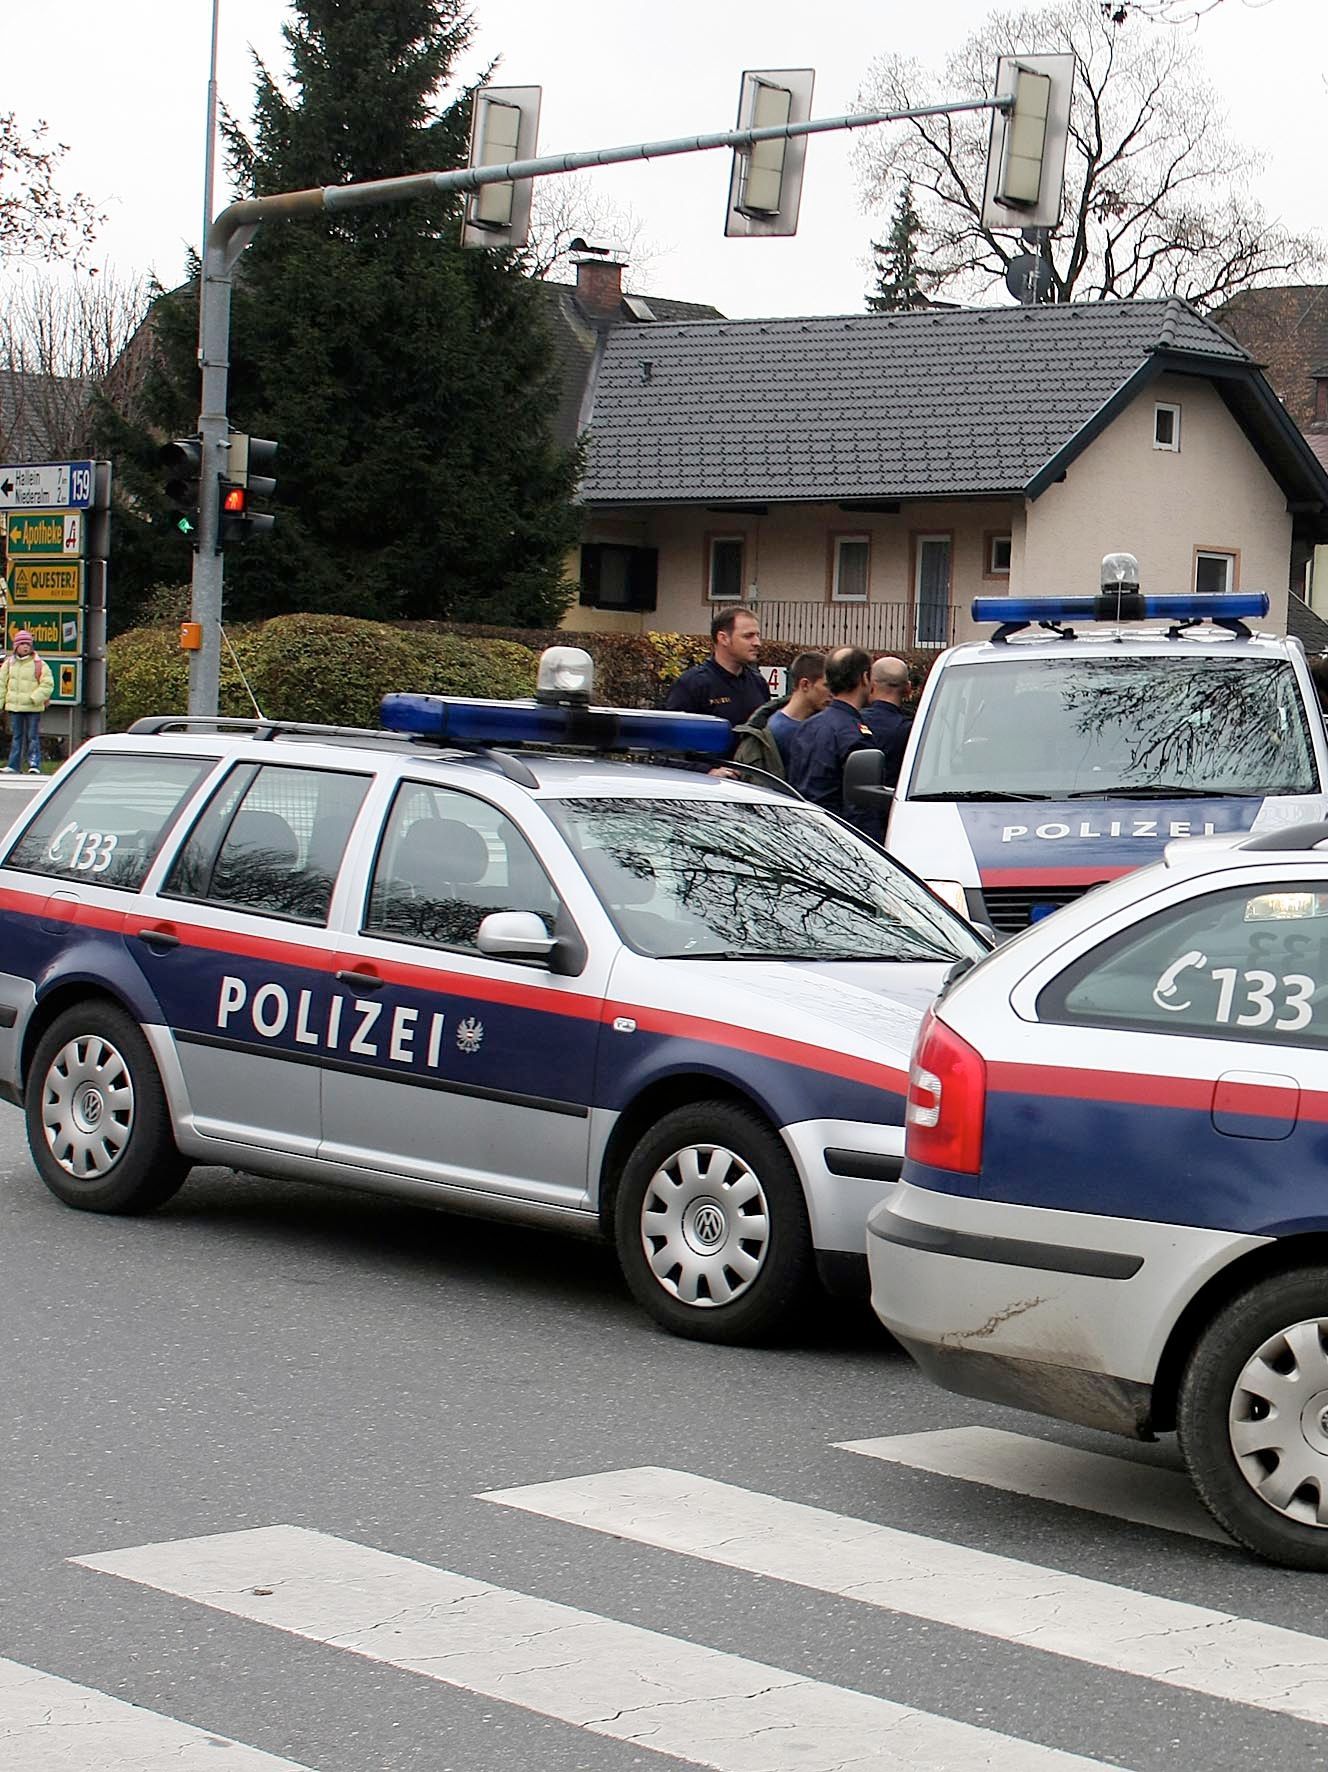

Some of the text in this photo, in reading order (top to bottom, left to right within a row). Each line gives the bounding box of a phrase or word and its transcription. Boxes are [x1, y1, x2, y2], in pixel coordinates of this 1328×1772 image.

[15, 469, 41, 486] Hallein
[72, 469, 90, 500] 159
[56, 487, 62, 503] 2
[23, 519, 63, 551] Apotheke
[31, 570, 76, 589] QUESTER!
[1001, 821, 1216, 842] POLIZEI
[70, 832, 118, 873] 133
[1209, 967, 1316, 1031] 133
[216, 975, 445, 1068] POLIZEI
